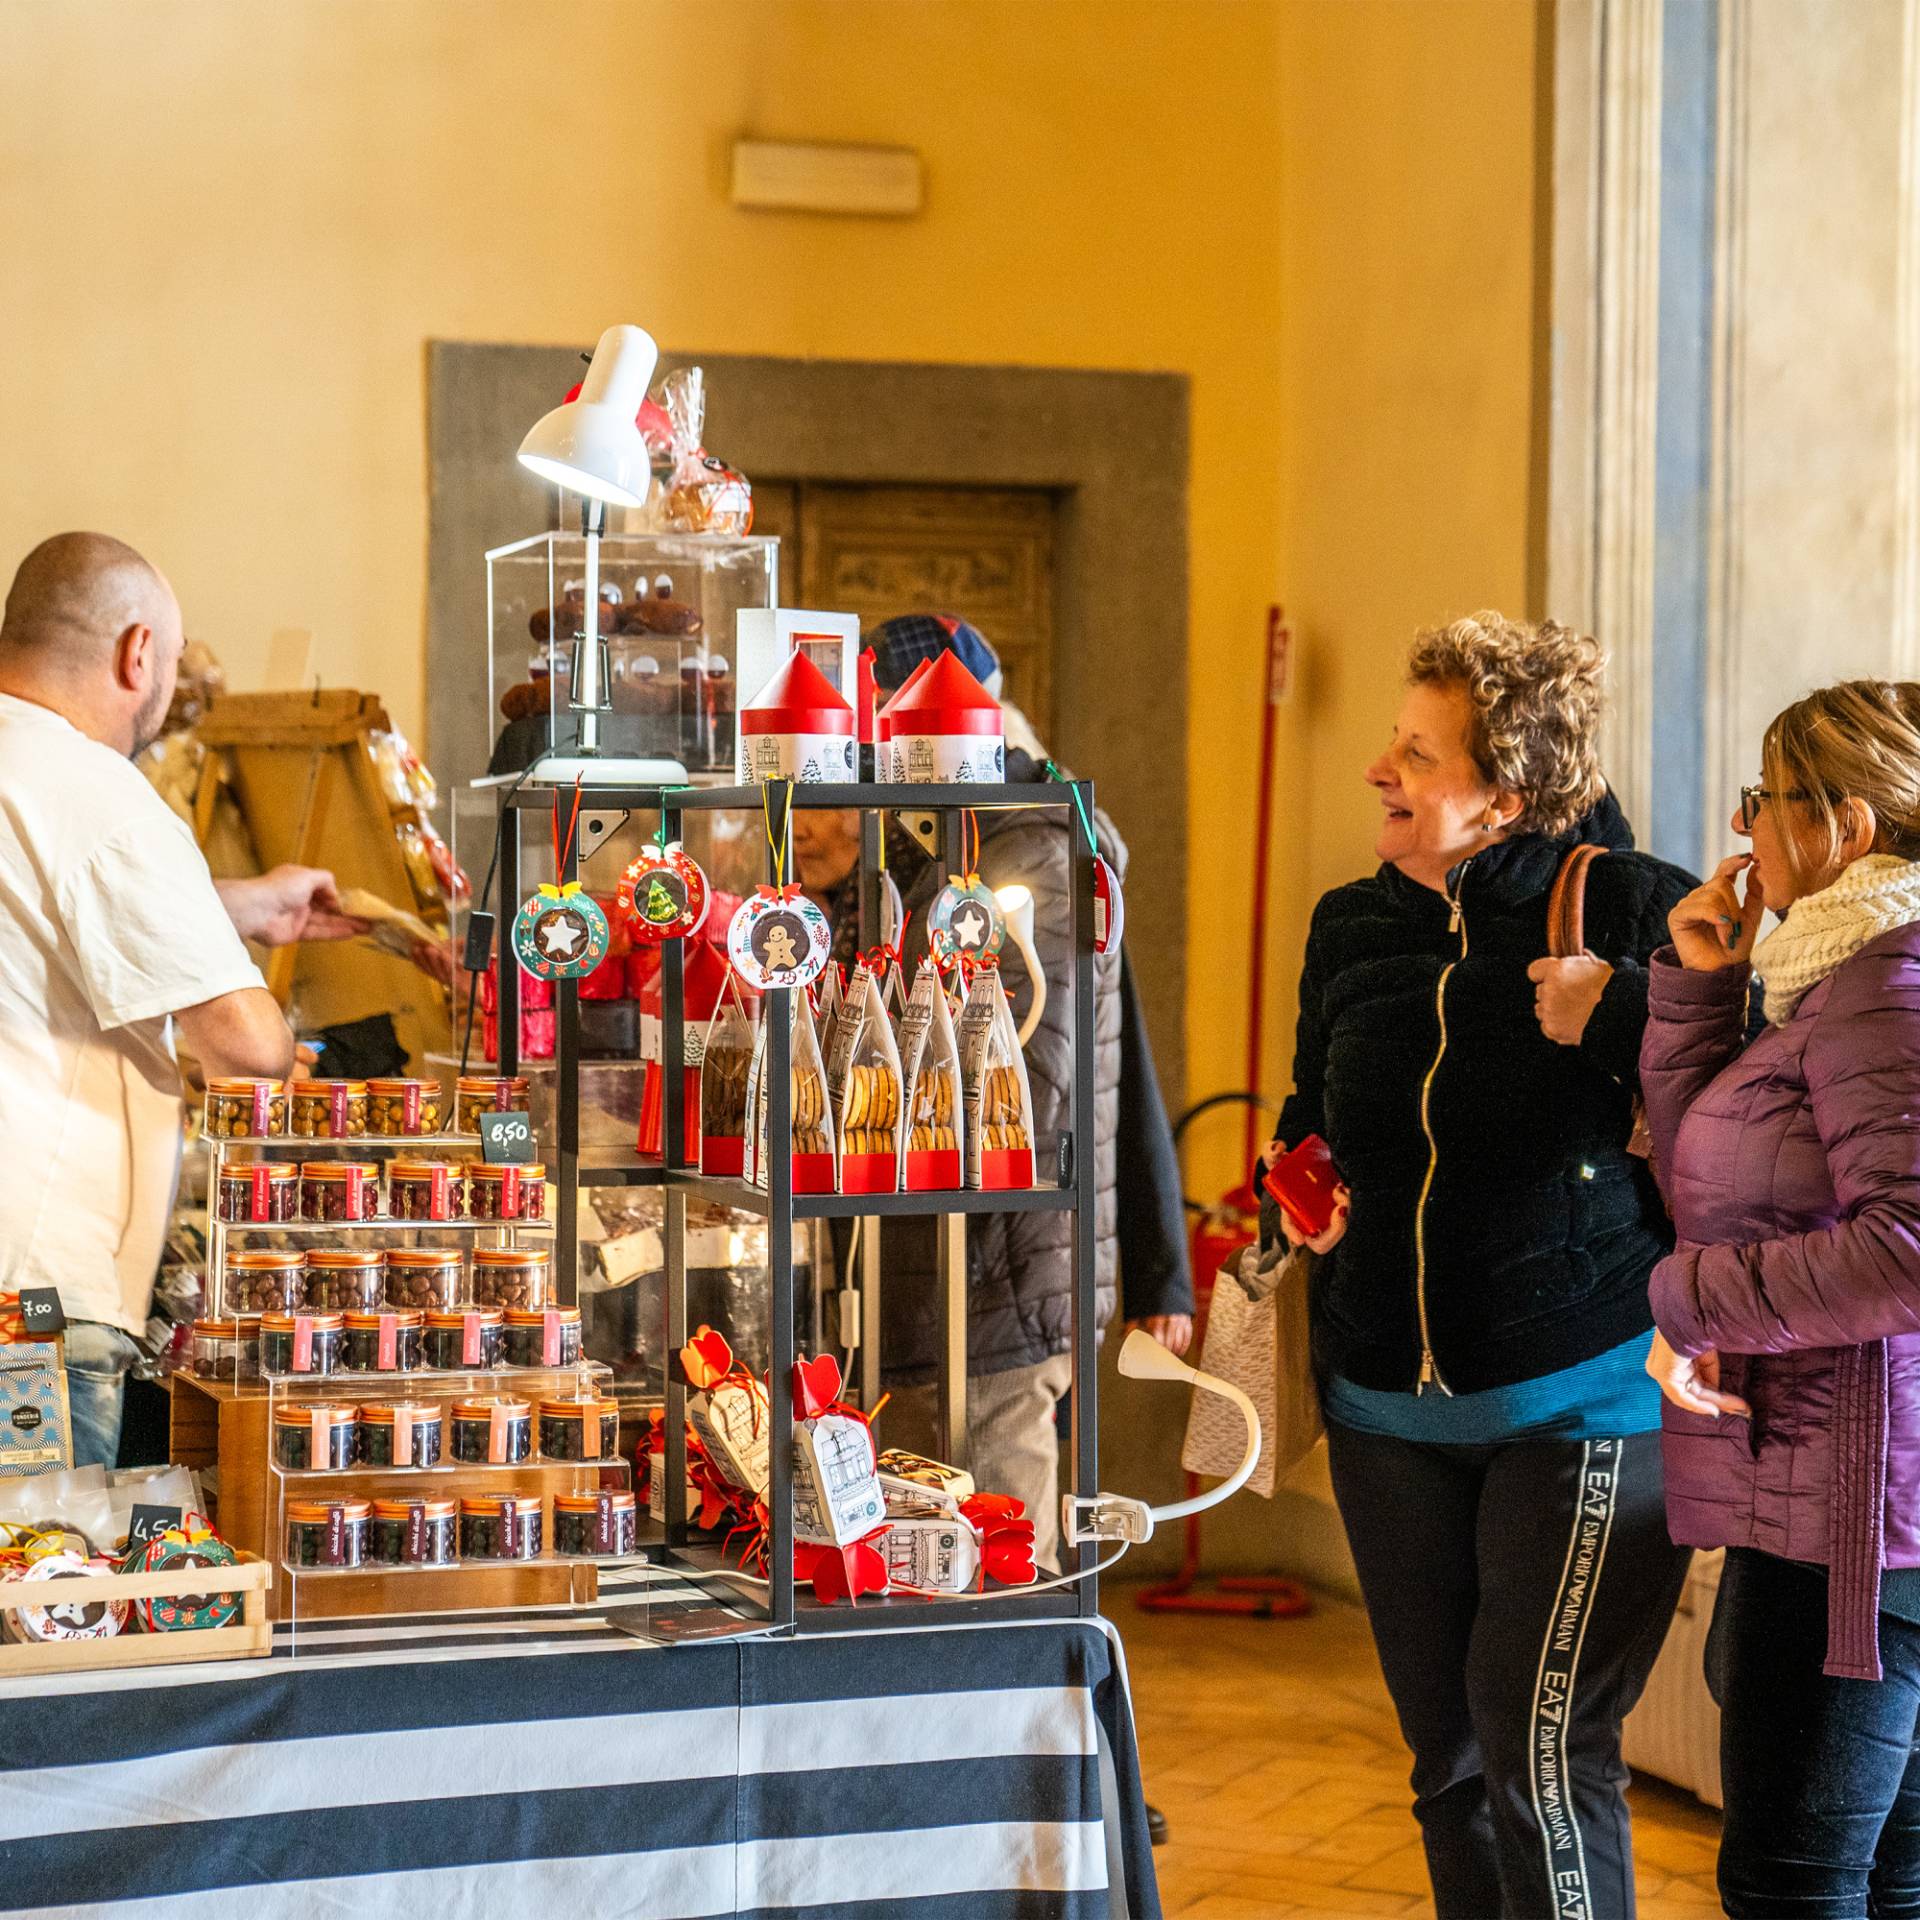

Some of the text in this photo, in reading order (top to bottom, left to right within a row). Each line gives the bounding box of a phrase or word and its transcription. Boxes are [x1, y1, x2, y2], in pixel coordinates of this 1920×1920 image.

[1585, 1472, 1611, 1520] EA7
[1573, 1521, 1600, 1583] EMPORIO
[1554, 1598, 1582, 1651] ARMANI
[1540, 1671, 1568, 1724] EA7
[1540, 1726, 1557, 1786] EMPORIO
[1544, 1800, 1573, 1851] ARMANI
